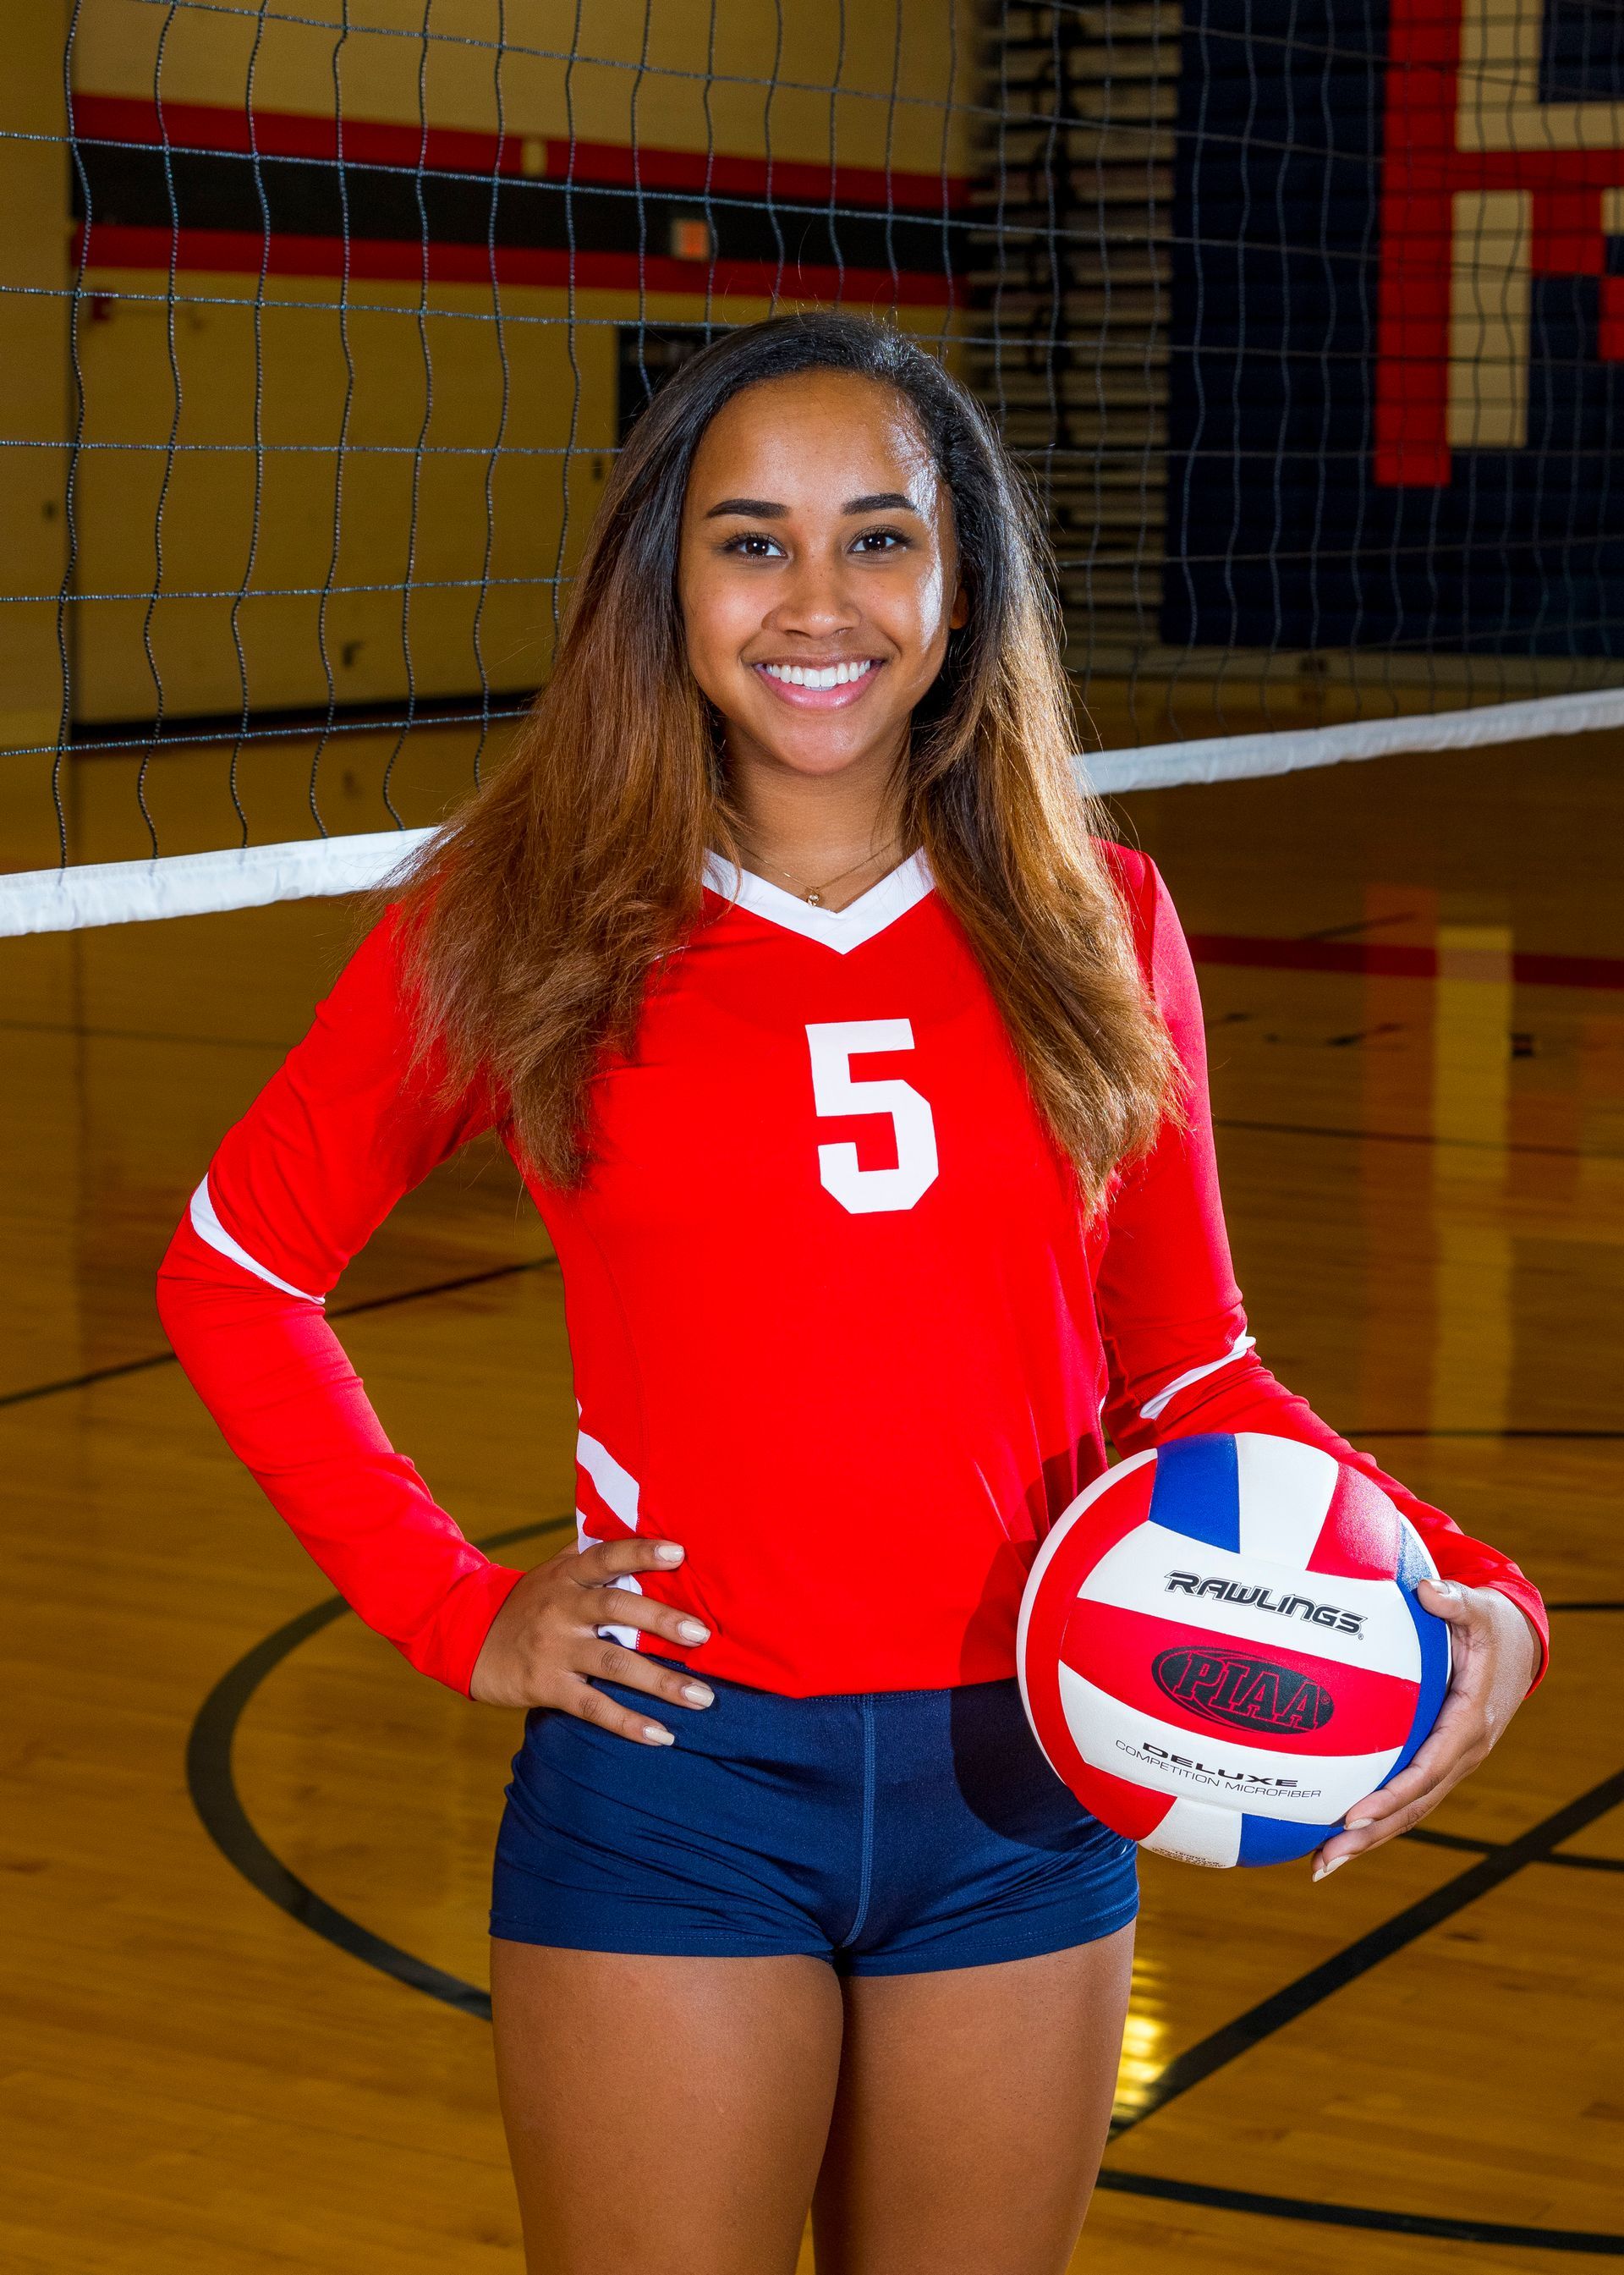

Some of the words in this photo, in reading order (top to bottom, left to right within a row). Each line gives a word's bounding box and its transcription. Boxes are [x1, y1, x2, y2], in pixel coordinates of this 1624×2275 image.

[805, 1019, 939, 1214] 5
[1164, 1569, 1368, 1636] RAWLINGS
[1172, 1652, 1320, 1732] PIAA
[1116, 1739, 1220, 1787] COMPETITION
[1226, 1781, 1321, 1798] MICROFIBER
[1143, 1742, 1298, 1787] DELUXE
